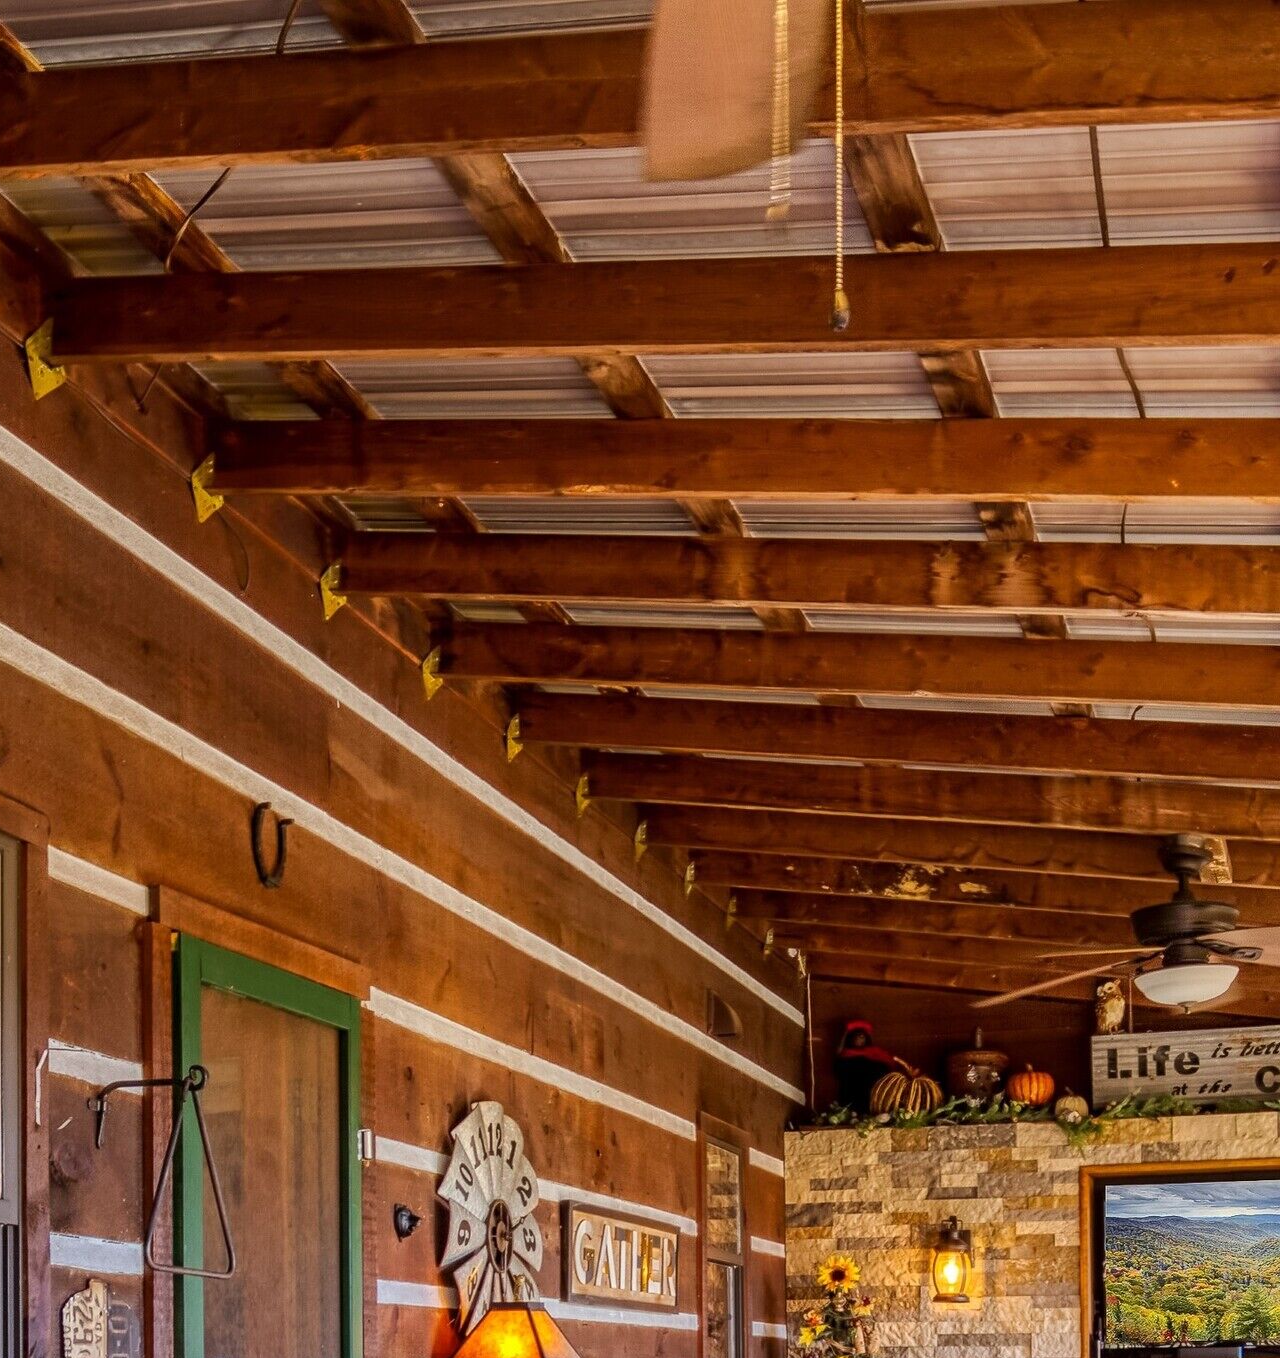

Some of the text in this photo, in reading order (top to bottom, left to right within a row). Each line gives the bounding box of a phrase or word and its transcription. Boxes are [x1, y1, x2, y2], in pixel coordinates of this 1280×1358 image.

[1107, 1045, 1200, 1079] Life
[1211, 1043, 1232, 1059] is
[1171, 1083, 1188, 1096] at
[470, 1127, 488, 1170] 11
[488, 1123, 502, 1157] 12
[506, 1140, 517, 1169] 1
[455, 1163, 473, 1202] 10
[517, 1176, 532, 1207] 2
[523, 1228, 536, 1252] 3
[575, 1219, 677, 1297] GATHER
